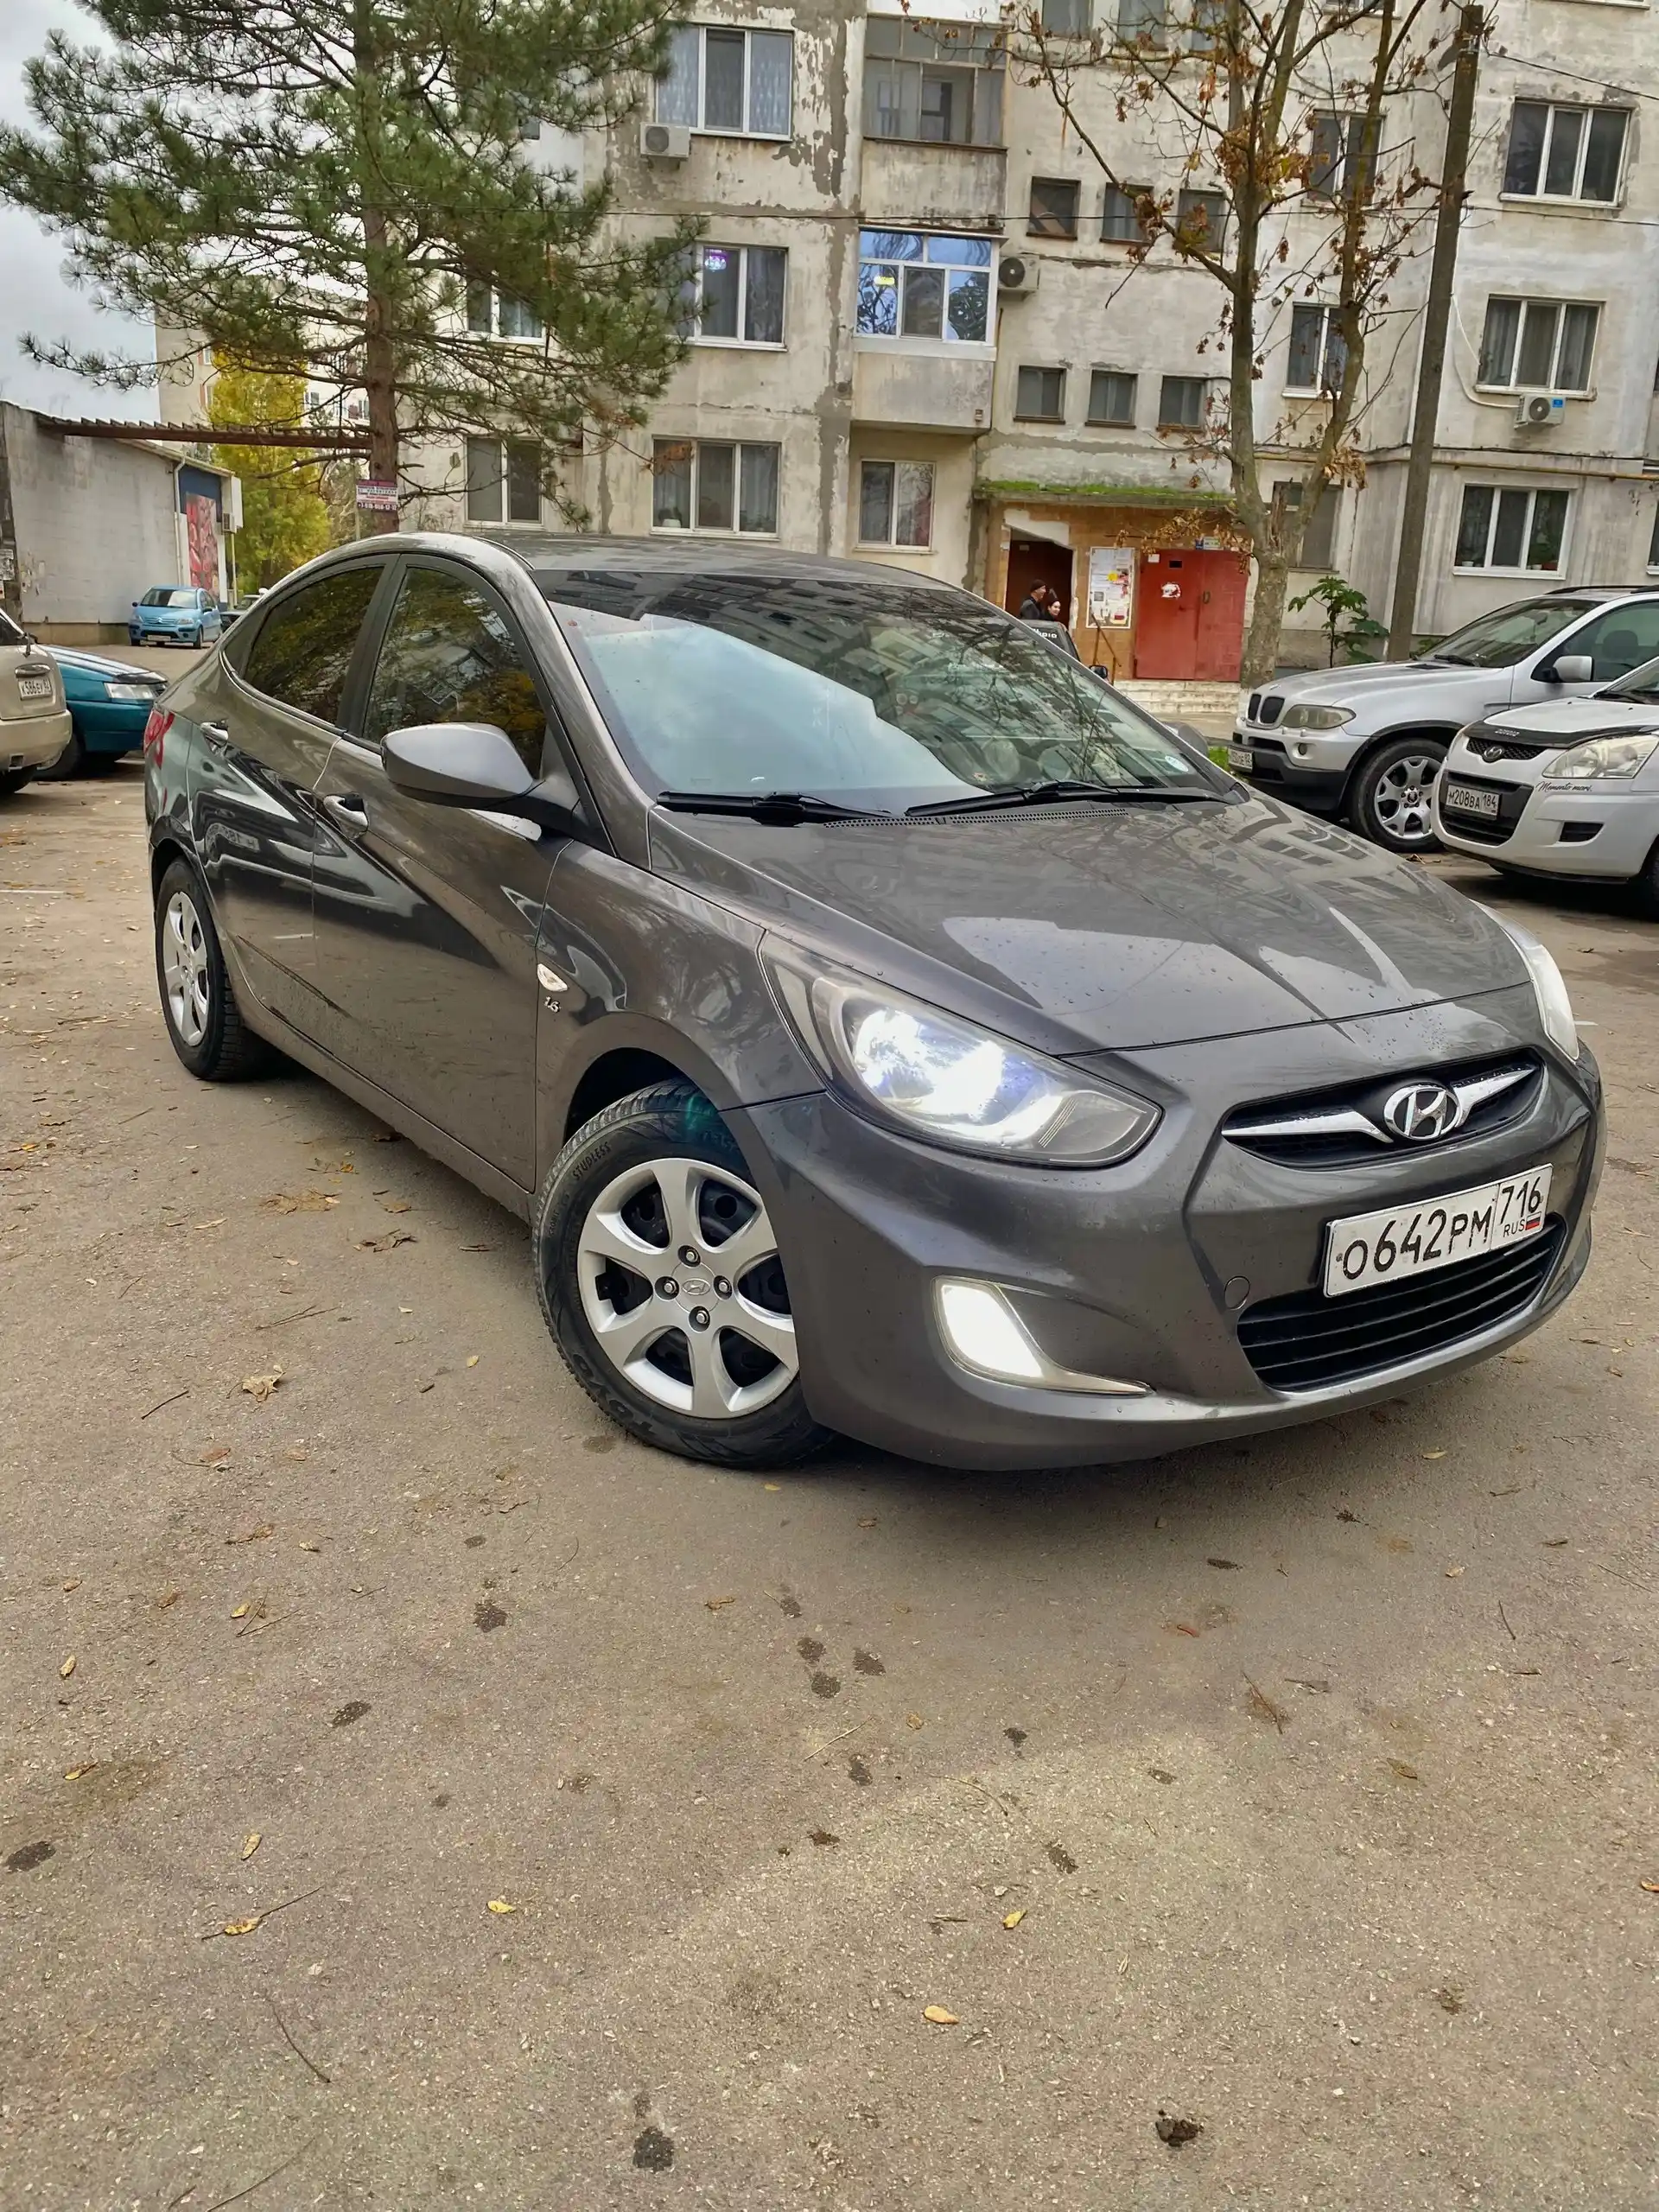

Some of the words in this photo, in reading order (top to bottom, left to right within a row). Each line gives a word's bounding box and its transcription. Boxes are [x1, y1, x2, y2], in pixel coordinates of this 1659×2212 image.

[1448, 789, 1481, 809] М208ВА
[1483, 793, 1497, 808] 184
[571, 1141, 612, 1181] STUDLESS
[1342, 1205, 1493, 1281] О642РМ
[1500, 1176, 1543, 1224] 716
[1503, 1220, 1526, 1238] RUS
